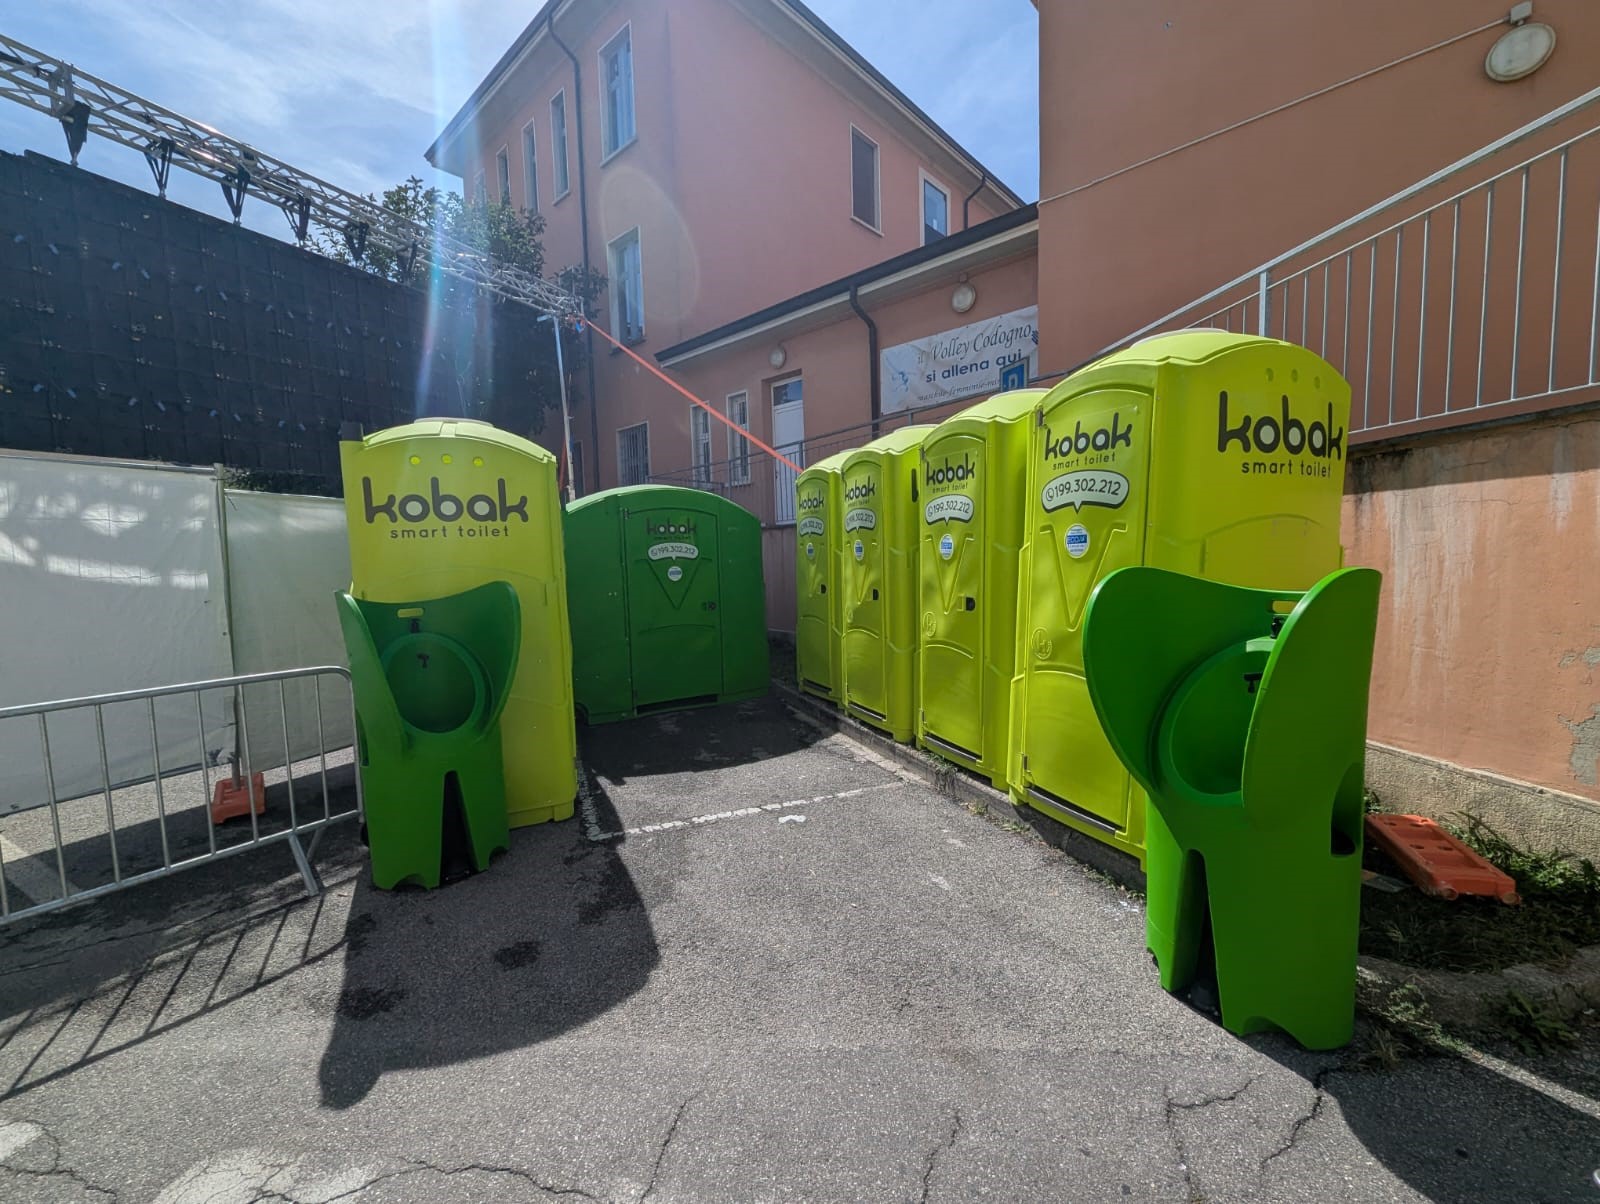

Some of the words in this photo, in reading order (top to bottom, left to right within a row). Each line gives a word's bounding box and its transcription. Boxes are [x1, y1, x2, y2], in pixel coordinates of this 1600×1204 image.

[931, 336, 970, 361] Volley
[973, 323, 1032, 353] Codogno
[926, 369, 936, 383] si
[941, 359, 989, 380] allena
[995, 348, 1022, 368] qui
[1045, 412, 1133, 461] kobak
[1218, 390, 1343, 460] kobak
[926, 453, 975, 486] kobak
[1052, 458, 1079, 471] smart
[1084, 452, 1116, 465] toilet
[1241, 459, 1293, 475] smart
[1300, 460, 1331, 478] toilet
[362, 476, 529, 523] kobak
[798, 487, 825, 511] kobak
[844, 475, 875, 502] kobak
[1054, 478, 1121, 498] 199.302.212
[390, 525, 448, 539] smart
[458, 525, 509, 538] toilet
[645, 517, 697, 535] kobak
